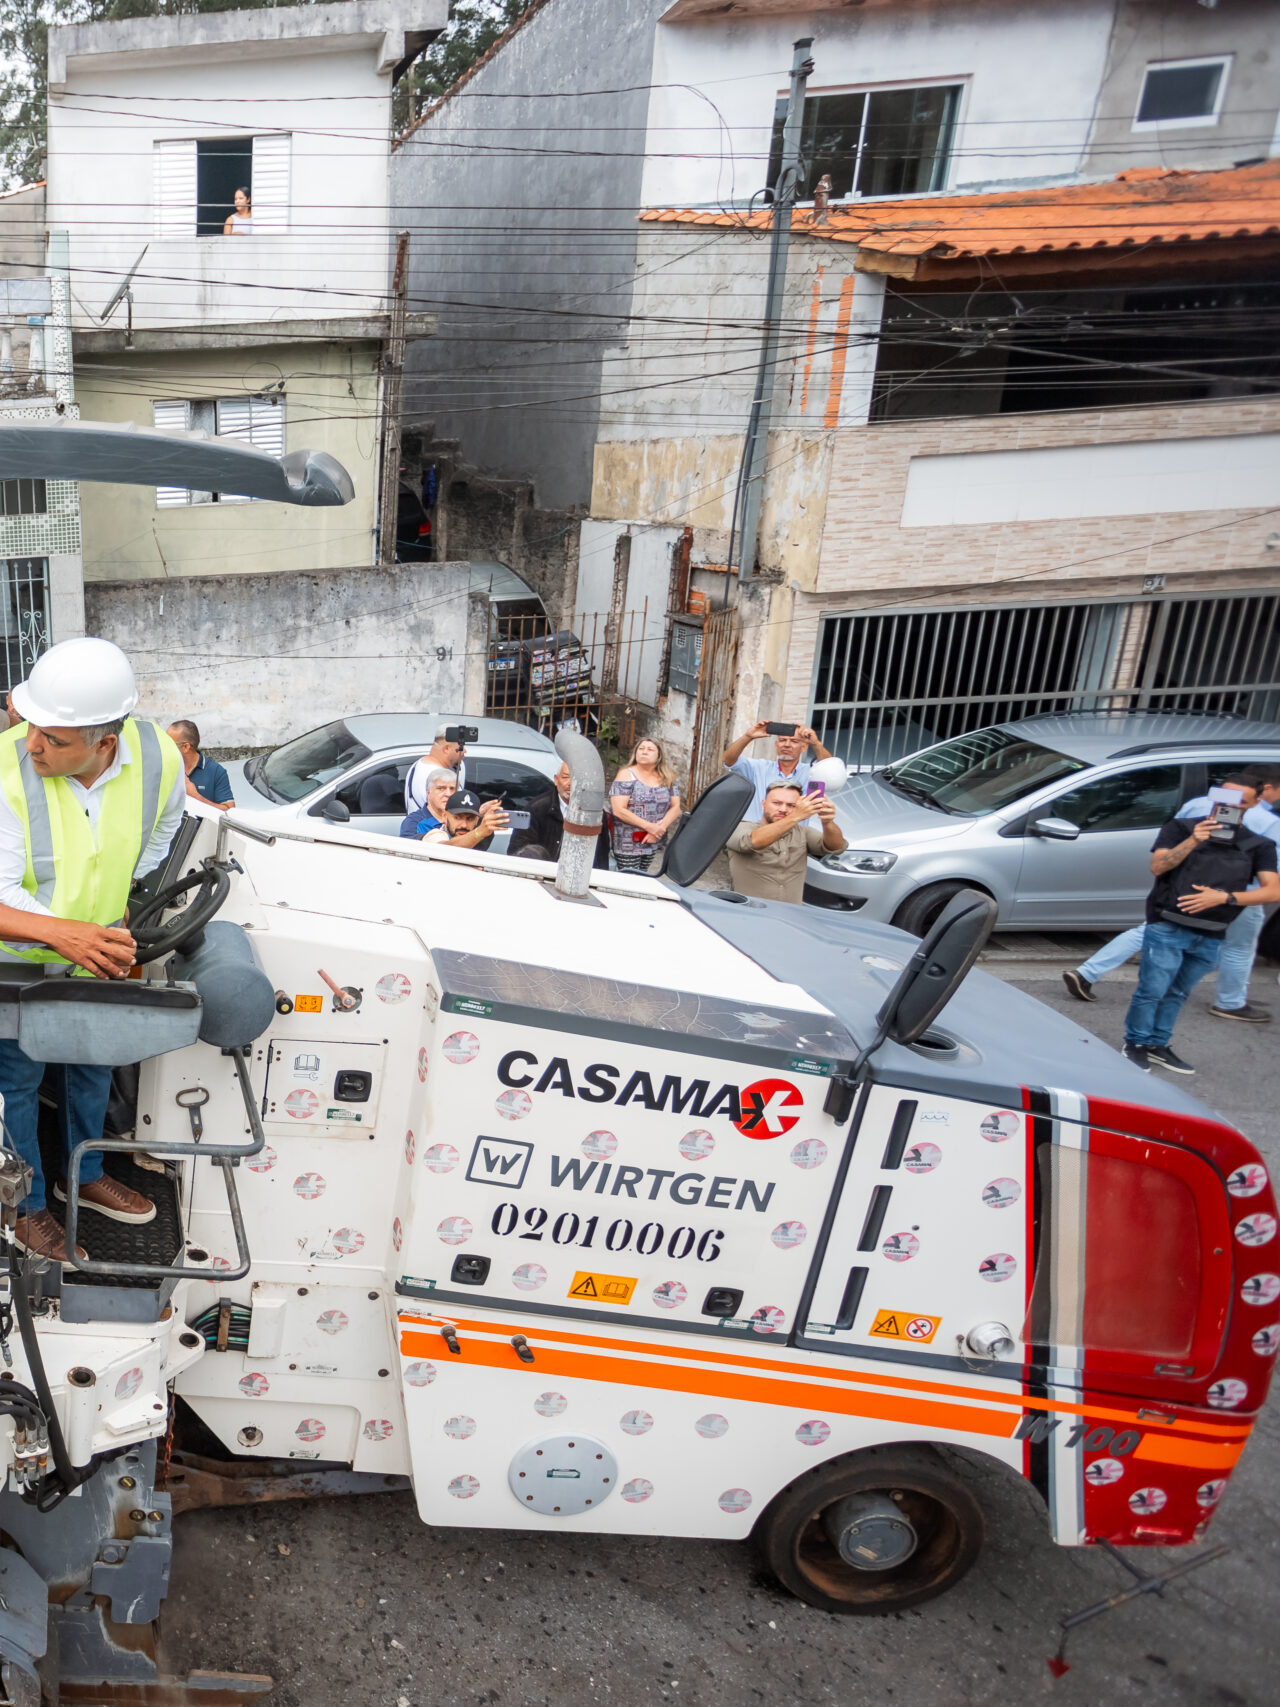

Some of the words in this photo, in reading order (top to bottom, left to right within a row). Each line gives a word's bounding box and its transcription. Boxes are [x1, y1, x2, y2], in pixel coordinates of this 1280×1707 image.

[497, 1050, 804, 1133] CASAMAX
[550, 1155, 776, 1213] WIRTGEN
[491, 1203, 725, 1262] 02010006
[1014, 1415, 1062, 1443] W
[1064, 1424, 1140, 1456] 100
